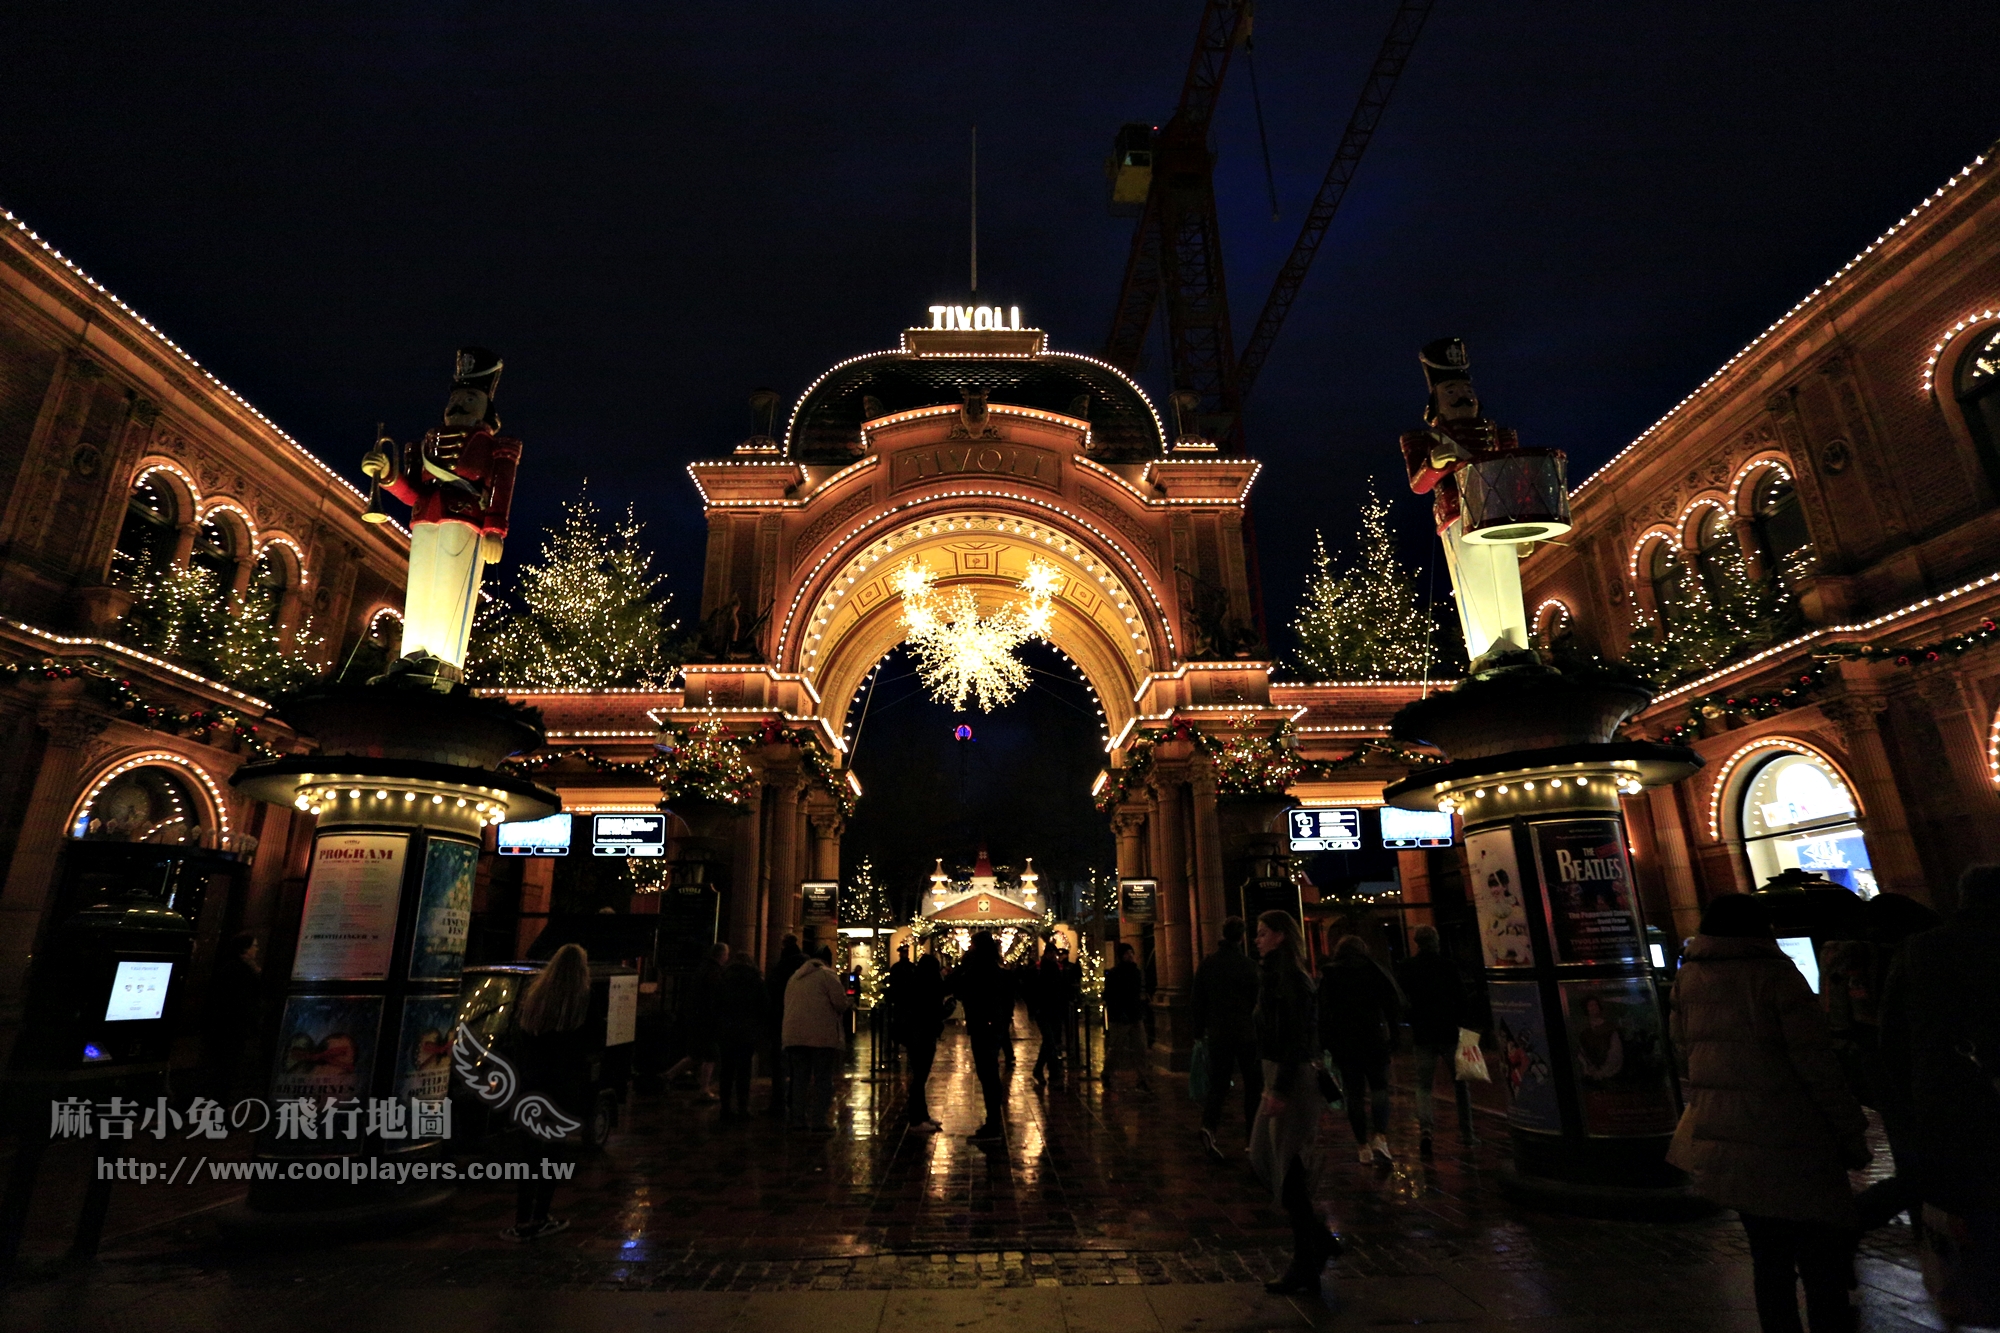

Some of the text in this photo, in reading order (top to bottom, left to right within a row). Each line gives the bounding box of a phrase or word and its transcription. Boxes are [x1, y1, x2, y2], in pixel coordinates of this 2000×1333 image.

[929, 306, 1020, 331] TIVOLI
[904, 448, 1044, 479] TIVOLI
[320, 849, 393, 860] PROGRAM
[1582, 847, 1596, 857] THE
[1556, 849, 1622, 883] BEATLES
